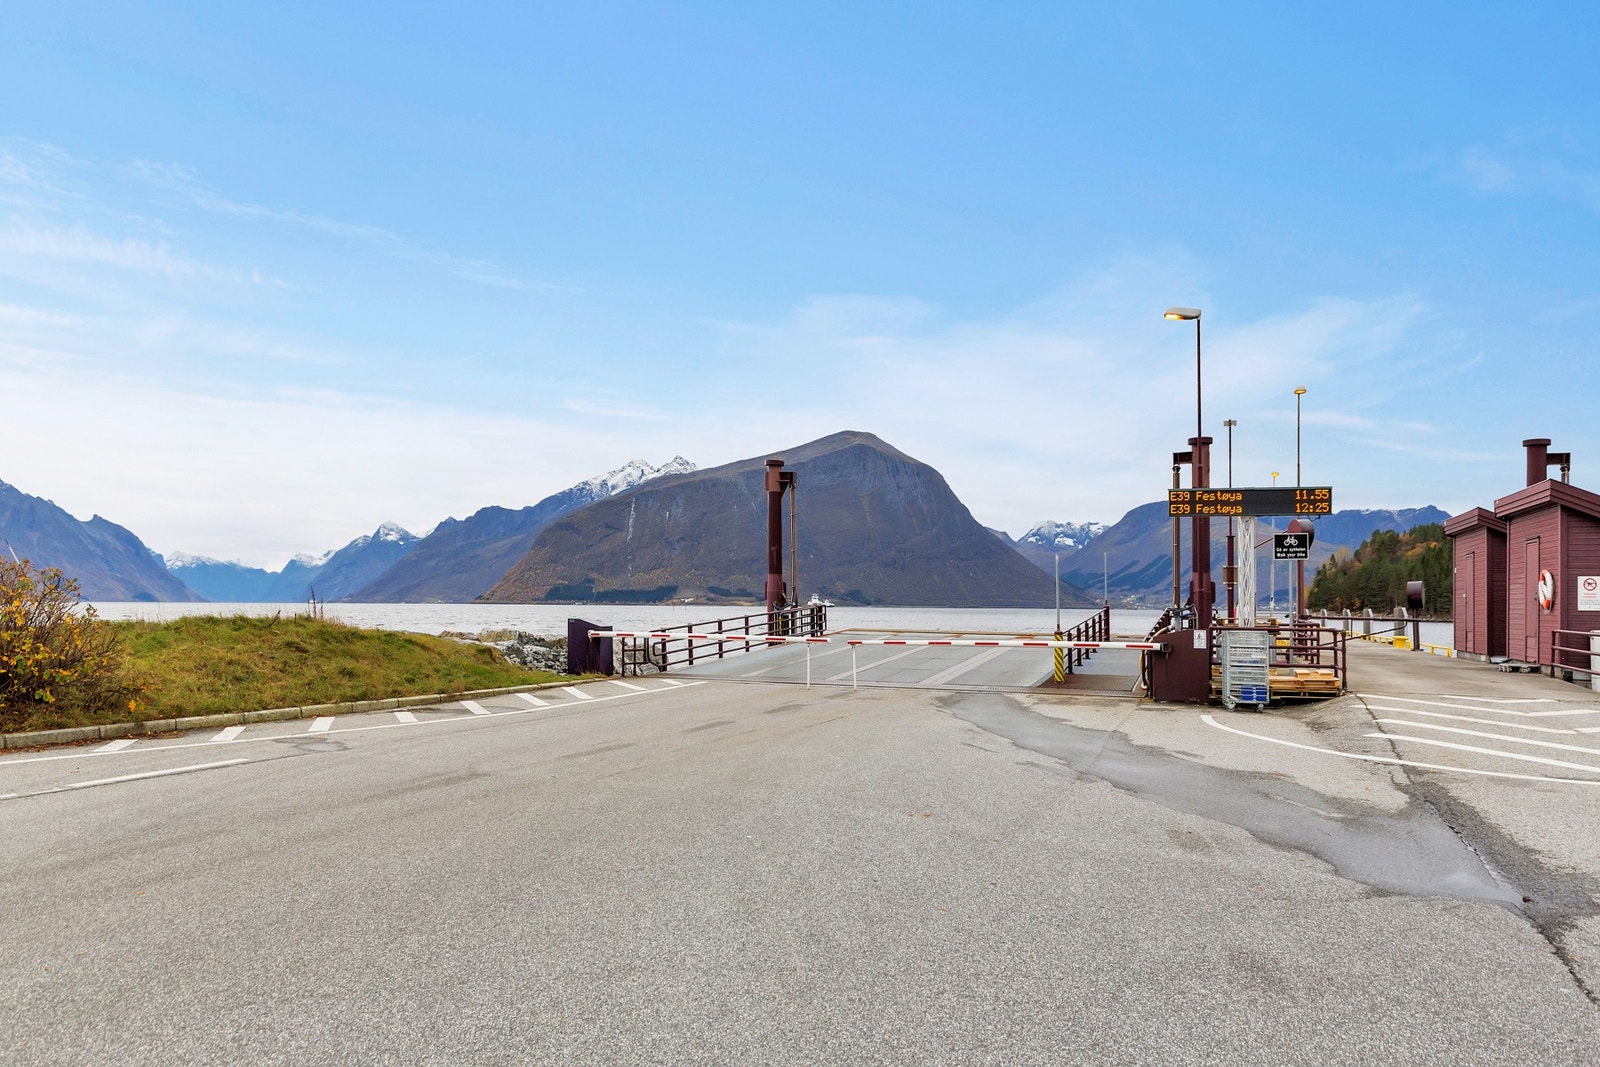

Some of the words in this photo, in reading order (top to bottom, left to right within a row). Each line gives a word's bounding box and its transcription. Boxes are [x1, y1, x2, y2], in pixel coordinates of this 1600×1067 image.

[1170, 491, 1190, 501] E39
[1195, 490, 1243, 502] Festøya
[1170, 504, 1190, 514] E39
[1195, 503, 1243, 515] Festøya
[1295, 502, 1329, 513] 12:25
